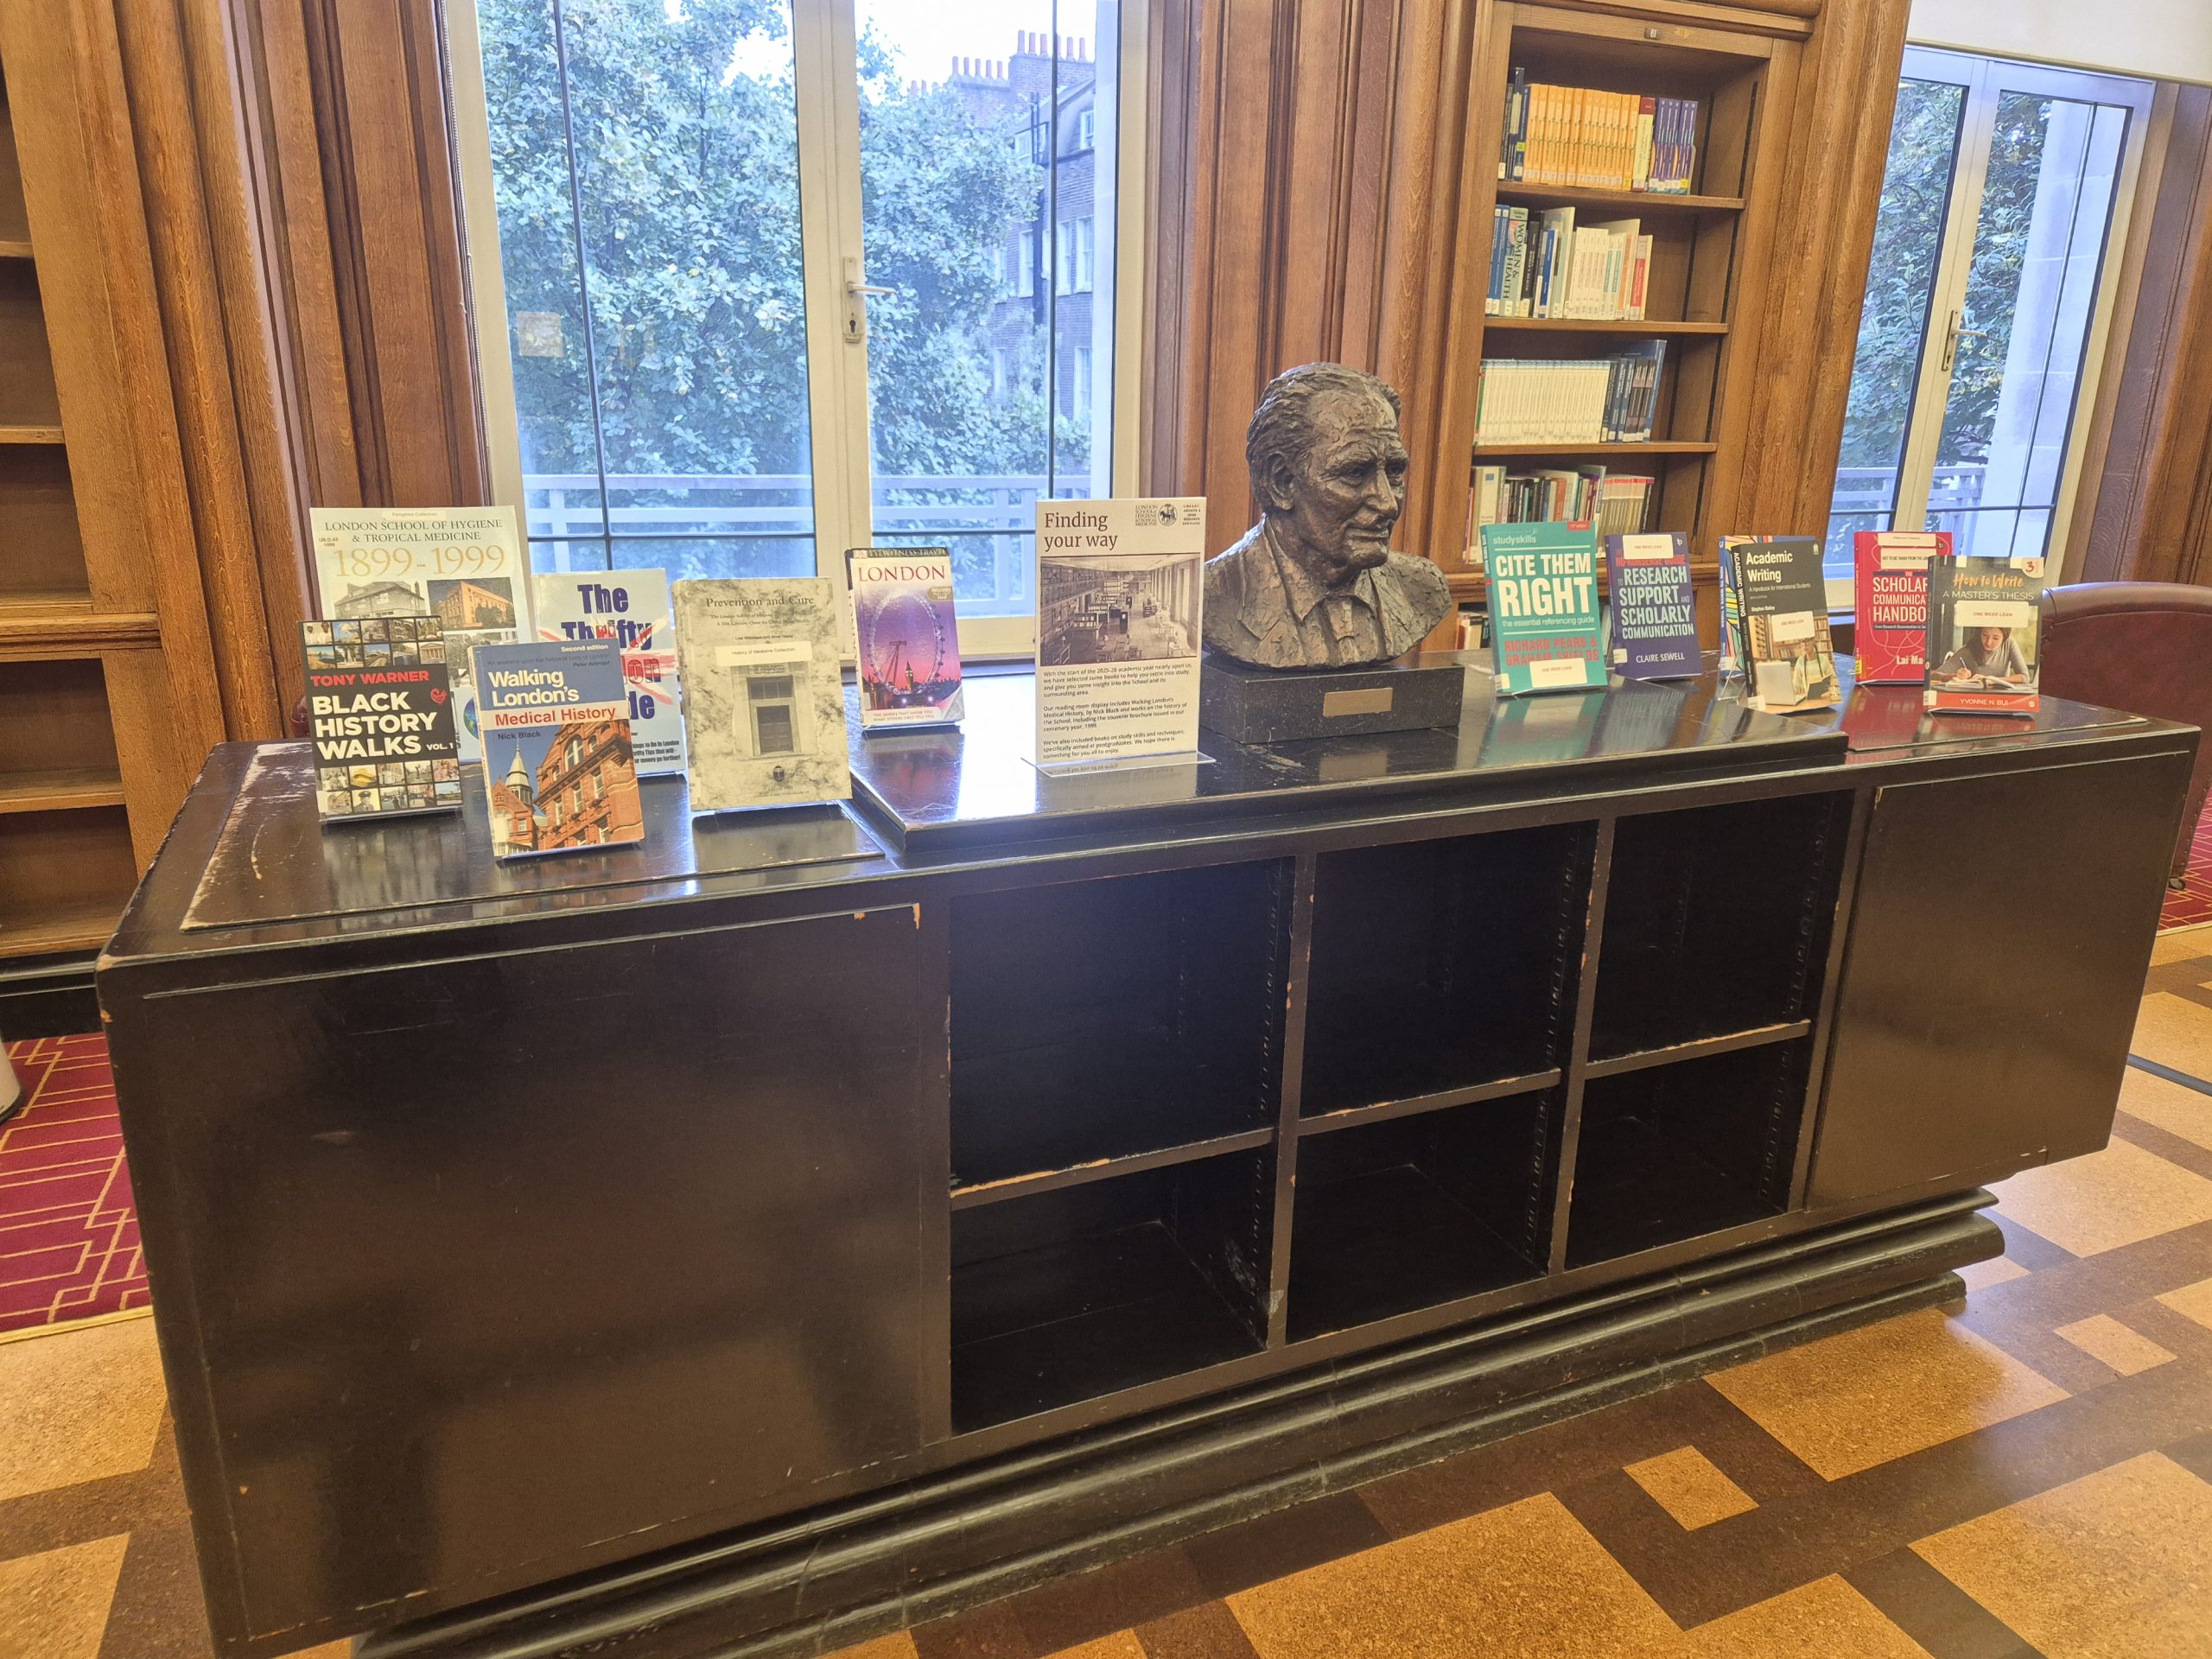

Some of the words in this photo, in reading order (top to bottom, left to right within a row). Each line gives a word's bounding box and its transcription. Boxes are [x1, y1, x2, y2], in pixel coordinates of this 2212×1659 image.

[1515, 224, 1524, 269] WOMEN
[1503, 257, 1514, 299] HEALTH
[325, 522, 378, 531] LONDON
[381, 520, 429, 531] SCHOOL
[432, 520, 448, 530] OF
[451, 519, 503, 529] HYGIENE
[1045, 512, 1109, 532] Finding
[352, 534, 359, 543] &
[364, 533, 421, 543] TROPICAL
[424, 532, 480, 541] MEDICINE
[1044, 536, 1083, 551] your
[1086, 535, 1118, 550] way
[1493, 535, 1536, 545] studyskills
[1496, 555, 1536, 577] CITE
[1541, 553, 1591, 575] THEM
[1746, 550, 1794, 566] Academic
[859, 566, 945, 582] LONDON
[1733, 552, 1745, 588] ACADEMIC
[2025, 561, 2034, 572] 3
[1624, 566, 1688, 586] RESEARCH
[1747, 569, 1782, 583] Writing
[1953, 573, 1978, 589] How
[1980, 575, 1991, 585] to
[1993, 574, 2024, 588] Write
[577, 583, 629, 613] The
[706, 598, 762, 607] Prevention
[766, 595, 785, 605] and
[788, 595, 814, 604] Cure
[1497, 576, 1592, 617] RIGHT
[1619, 585, 1679, 607] SUPPORT
[1952, 591, 1999, 600] MASTER'S
[1513, 619, 1541, 627] essential
[1541, 616, 1577, 627] referencing
[1577, 616, 1595, 626] guide
[1620, 605, 1692, 626] SCHOLARLY
[561, 620, 652, 651] Thrifty
[1622, 623, 1694, 639] COMMUNICATION
[1504, 639, 1551, 652] RICHARD
[1554, 637, 1586, 649] PEARS
[1590, 636, 1598, 647] &
[1506, 652, 1554, 666] GRAHAM
[1636, 654, 1659, 664] CLAIRE
[1660, 652, 1685, 662] SEWELL
[1896, 656, 1909, 665] Lai
[1910, 655, 1923, 664] Ma
[310, 674, 356, 687] TONY
[359, 671, 429, 683] WARNER
[487, 669, 564, 688] Walking
[312, 691, 411, 715] BLACK
[492, 686, 580, 707] London's
[495, 709, 556, 727] Medical
[561, 706, 616, 721] History
[315, 712, 437, 738] HISTORY
[316, 735, 422, 760] WALKS
